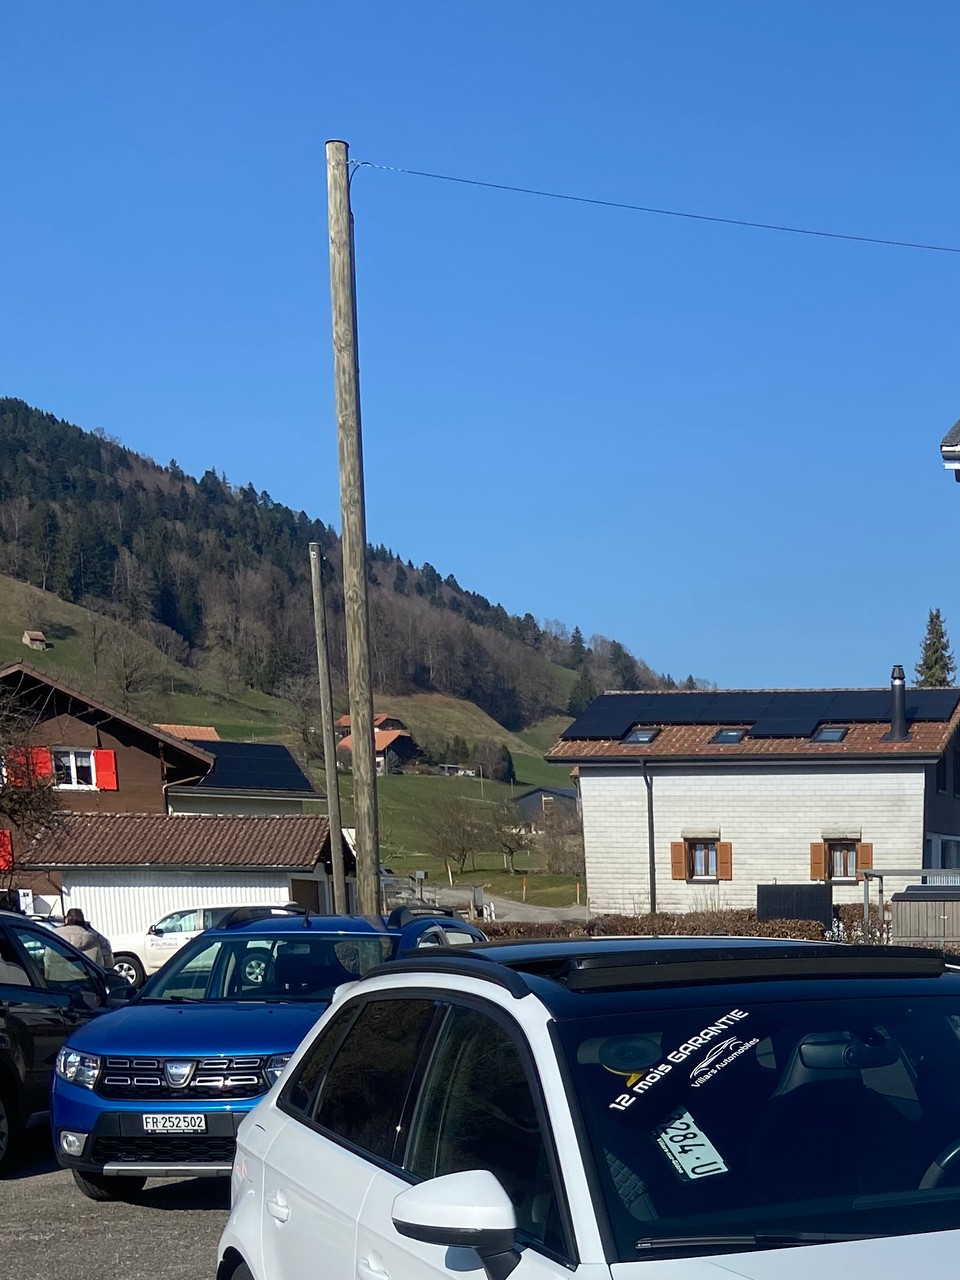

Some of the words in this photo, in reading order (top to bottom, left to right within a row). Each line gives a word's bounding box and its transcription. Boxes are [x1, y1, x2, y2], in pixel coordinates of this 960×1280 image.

[608, 1093, 636, 1111] 12
[632, 1063, 673, 1094] mois
[667, 1008, 749, 1064] GARANTIE
[691, 1068, 718, 1088] Villars
[715, 1037, 760, 1070] Automobiles
